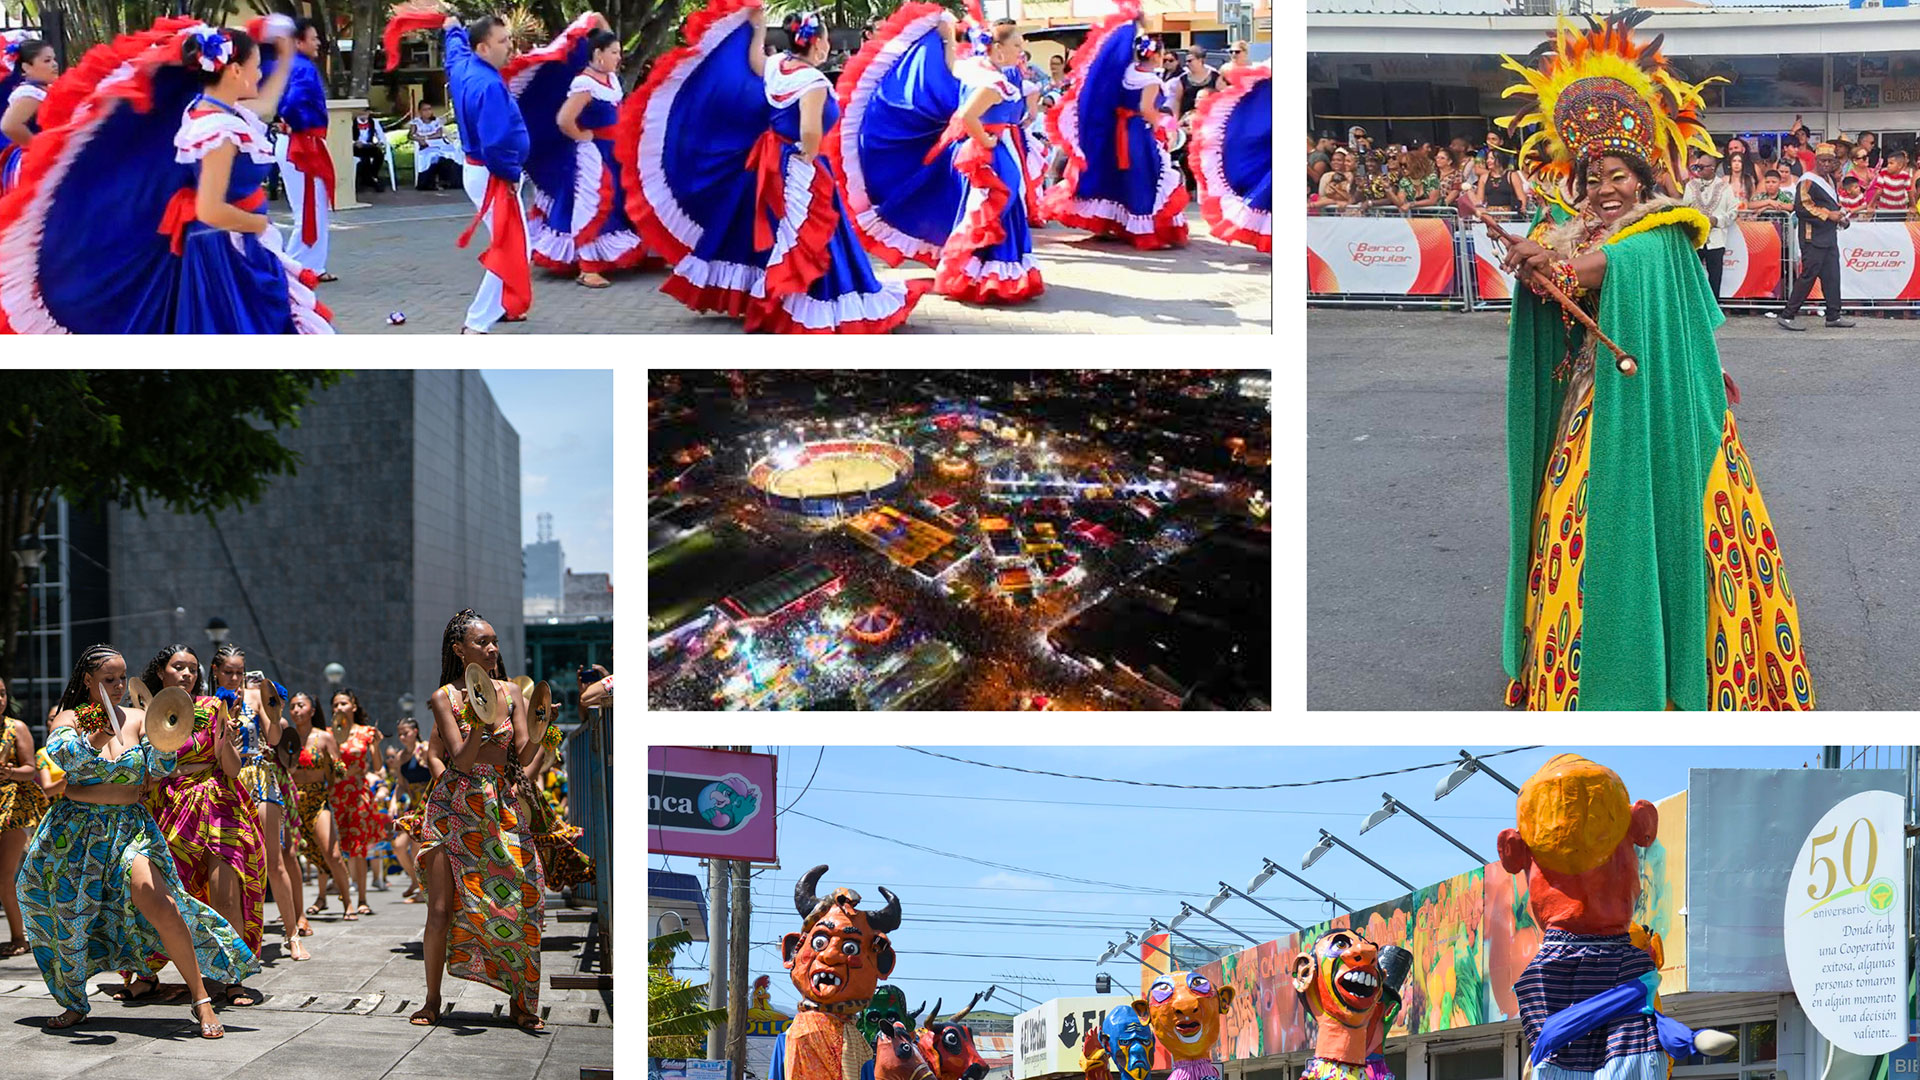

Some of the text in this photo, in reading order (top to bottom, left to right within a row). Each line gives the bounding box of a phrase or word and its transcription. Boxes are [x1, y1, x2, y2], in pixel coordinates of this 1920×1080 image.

[1357, 242, 1405, 252] Banco
[1851, 247, 1900, 257] Banco
[1352, 252, 1412, 264] Popular
[1846, 258, 1906, 270] Popular
[1807, 817, 1878, 900] 50
[1813, 904, 1866, 918] aniversario
[1842, 919, 1895, 938] Donde hay
[1819, 940, 1895, 959] una Cooperativa
[1822, 956, 1895, 975] exitosa, algunas
[1813, 976, 1896, 996] personas tomaron
[1812, 993, 1896, 1012] en algún momento
[1839, 1007, 1896, 1023] una decisión
[1854, 1025, 1897, 1039] valiente...
